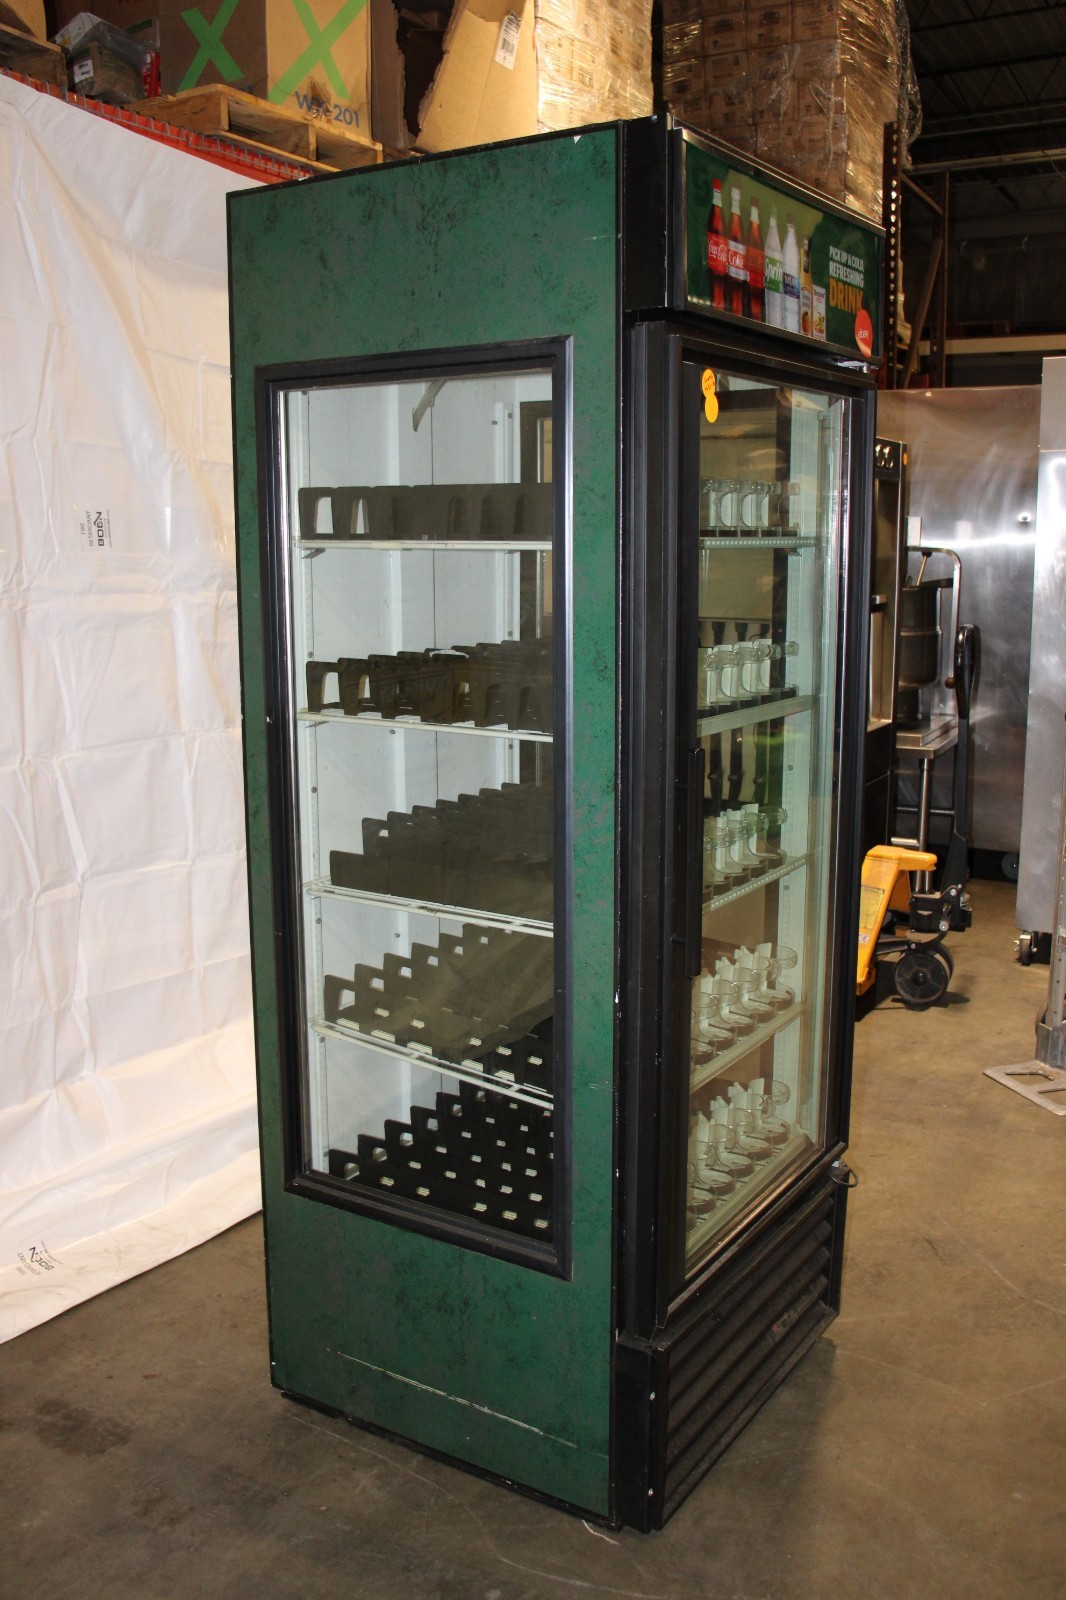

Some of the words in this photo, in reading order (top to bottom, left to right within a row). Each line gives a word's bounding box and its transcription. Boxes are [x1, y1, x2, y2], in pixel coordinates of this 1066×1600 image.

[333, 103, 360, 128] 201
[728, 250, 744, 269] Coke
[829, 245, 841, 261] PICK
[841, 250, 848, 264] UP
[852, 255, 865, 272] COLD,
[829, 261, 865, 287] REFRESHING
[829, 279, 864, 314] DRINK
[86, 510, 94, 547] RETARDANT
